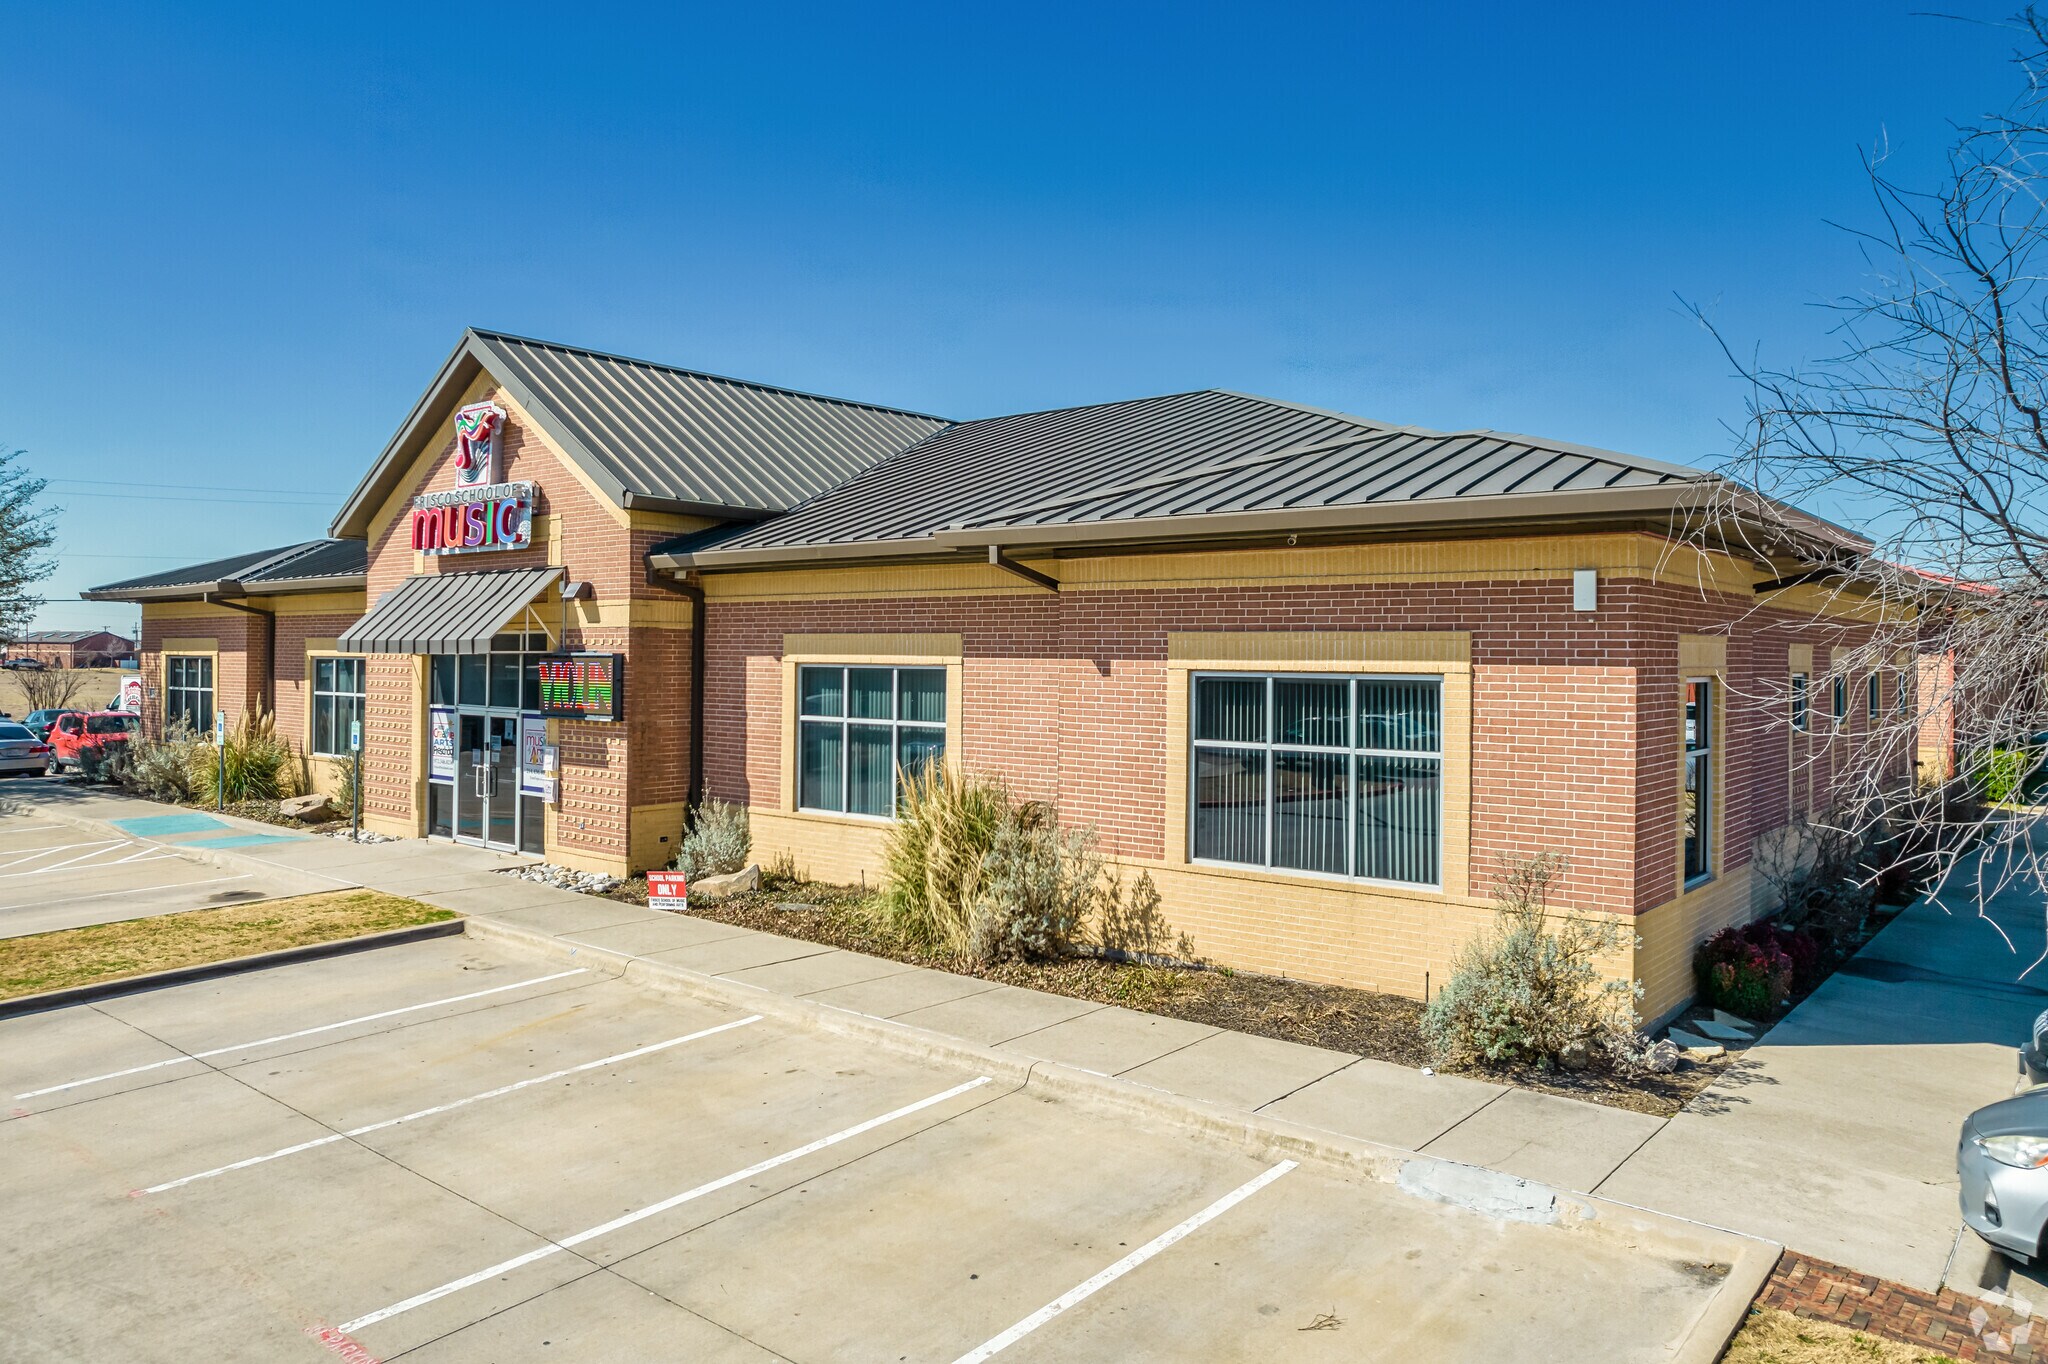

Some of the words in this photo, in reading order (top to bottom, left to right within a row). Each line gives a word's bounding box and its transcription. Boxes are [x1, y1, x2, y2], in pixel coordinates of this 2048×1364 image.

[414, 493, 451, 508] FRISCO
[454, 486, 500, 503] SCHOOL
[503, 484, 517, 498] OF
[657, 884, 677, 896] ONLY
